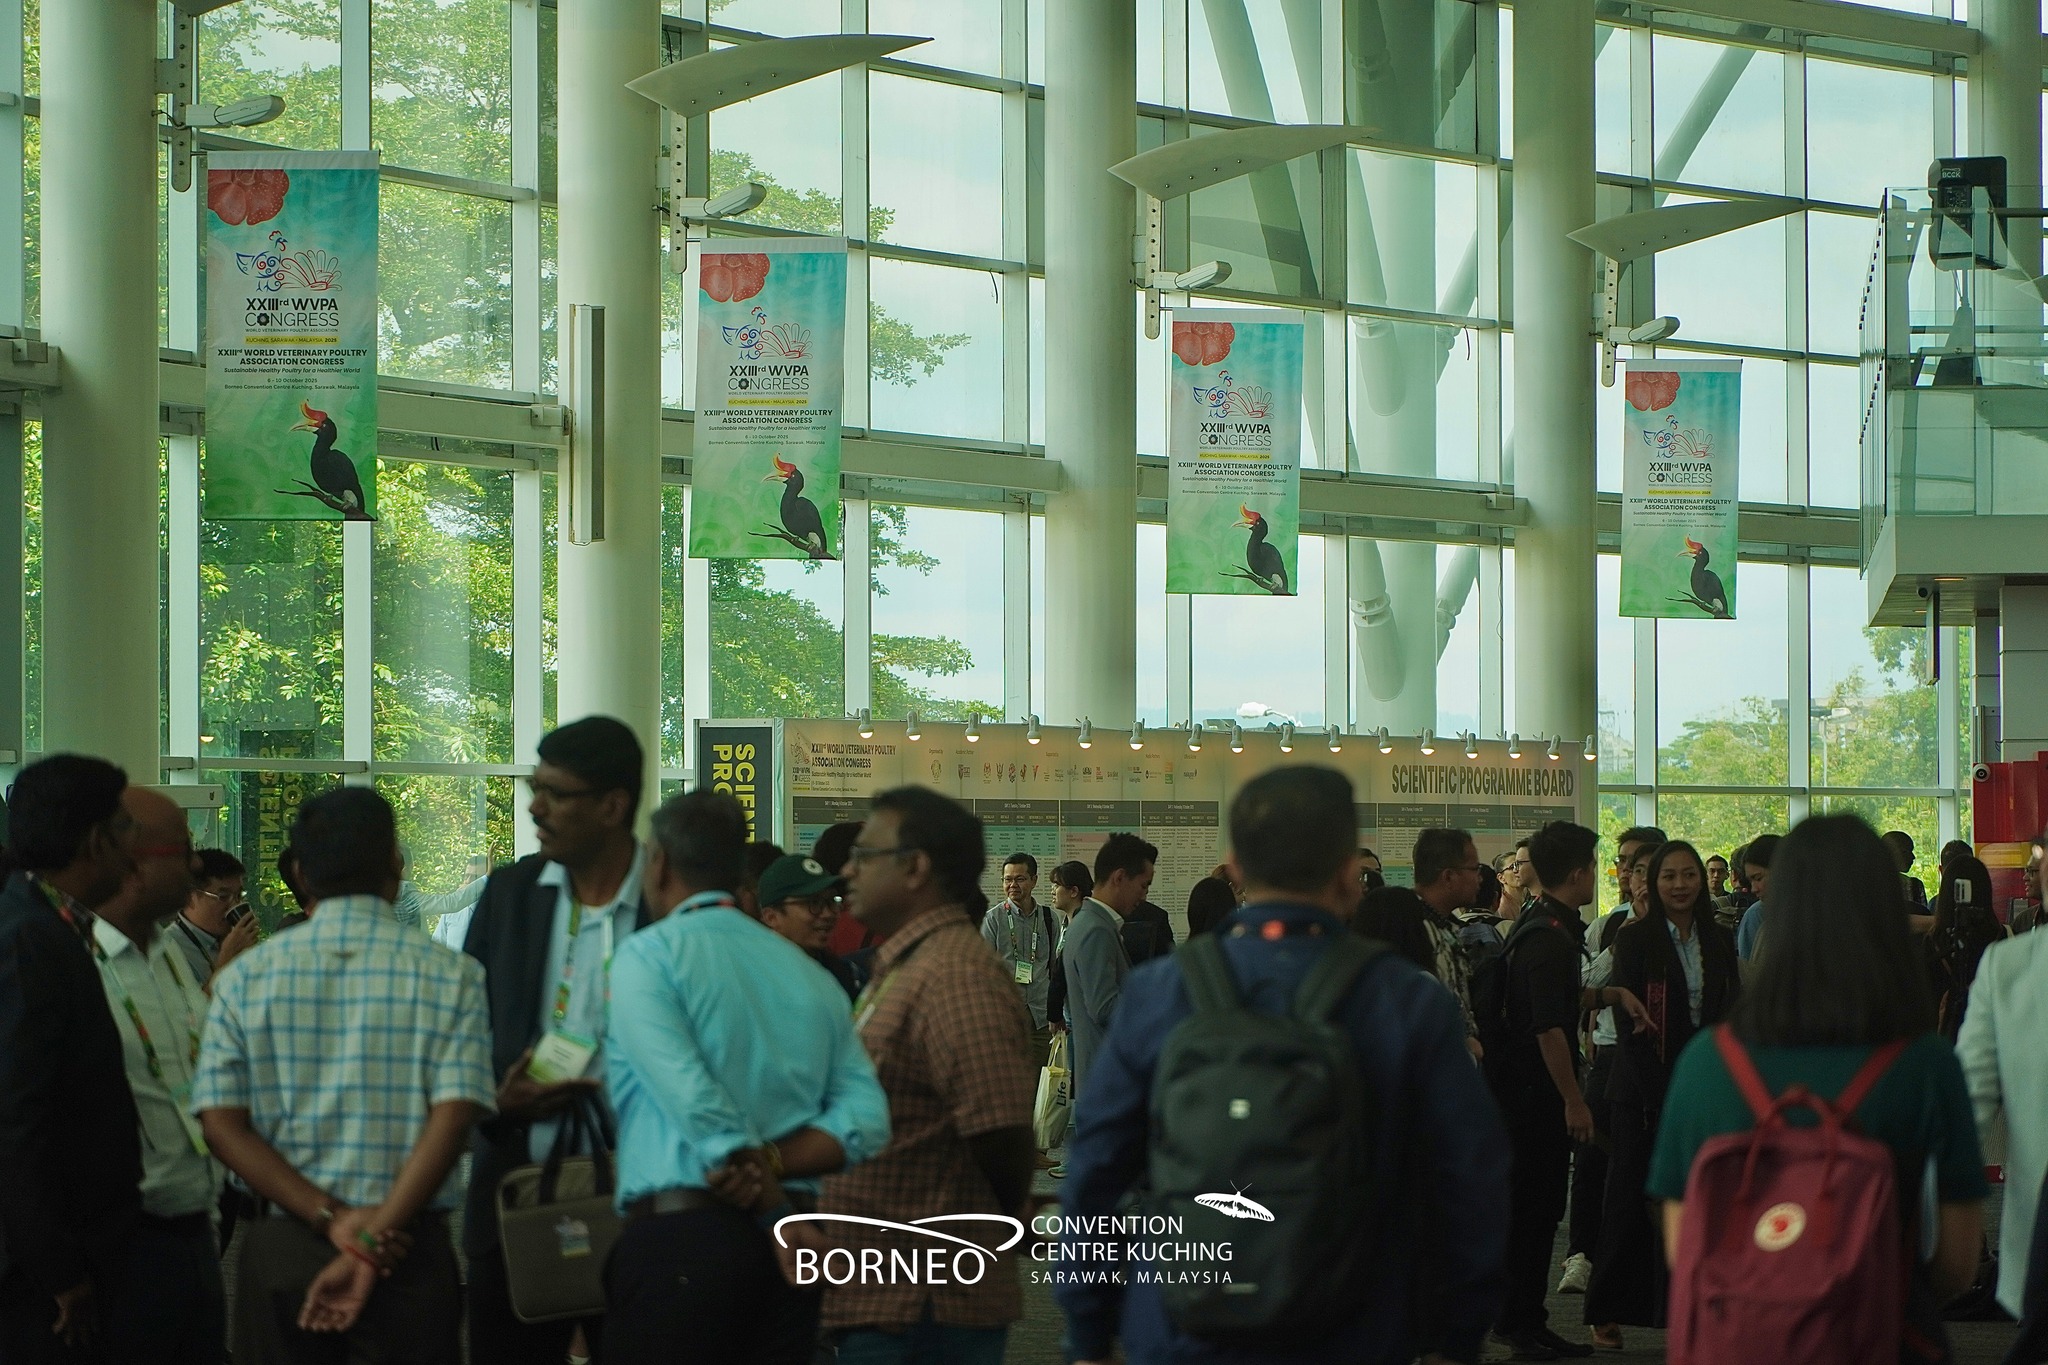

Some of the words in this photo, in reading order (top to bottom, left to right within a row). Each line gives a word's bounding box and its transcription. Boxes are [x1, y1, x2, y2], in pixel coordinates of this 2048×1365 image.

[246, 298, 289, 311] XXIIIrd
[292, 298, 338, 311] WVPA
[245, 312, 339, 327] CONGRESS
[729, 365, 766, 376] XXIIIrd
[768, 365, 809, 376] WVPA
[728, 378, 809, 390] CONGRESS
[1200, 423, 1234, 433] XXIIIrd
[1235, 424, 1271, 434] WVPA
[1199, 434, 1272, 447] CONGRESS
[1649, 463, 1679, 472] XXIIIrd
[1680, 463, 1712, 472] WVPA
[1648, 472, 1713, 484] CONGRESS
[827, 744, 844, 754] WORLD
[845, 744, 875, 755] VETERINARY
[875, 744, 897, 755] POULTRY
[812, 757, 845, 768] ASSOCIATION
[846, 758, 872, 768] CONGRESS
[1392, 764, 1458, 795] SCIENTIFIC
[1460, 766, 1533, 796] PROGRAMME
[1534, 768, 1574, 797] BOARD
[735, 743, 755, 843] SCIENT
[1057, 1081, 1067, 1107] Life
